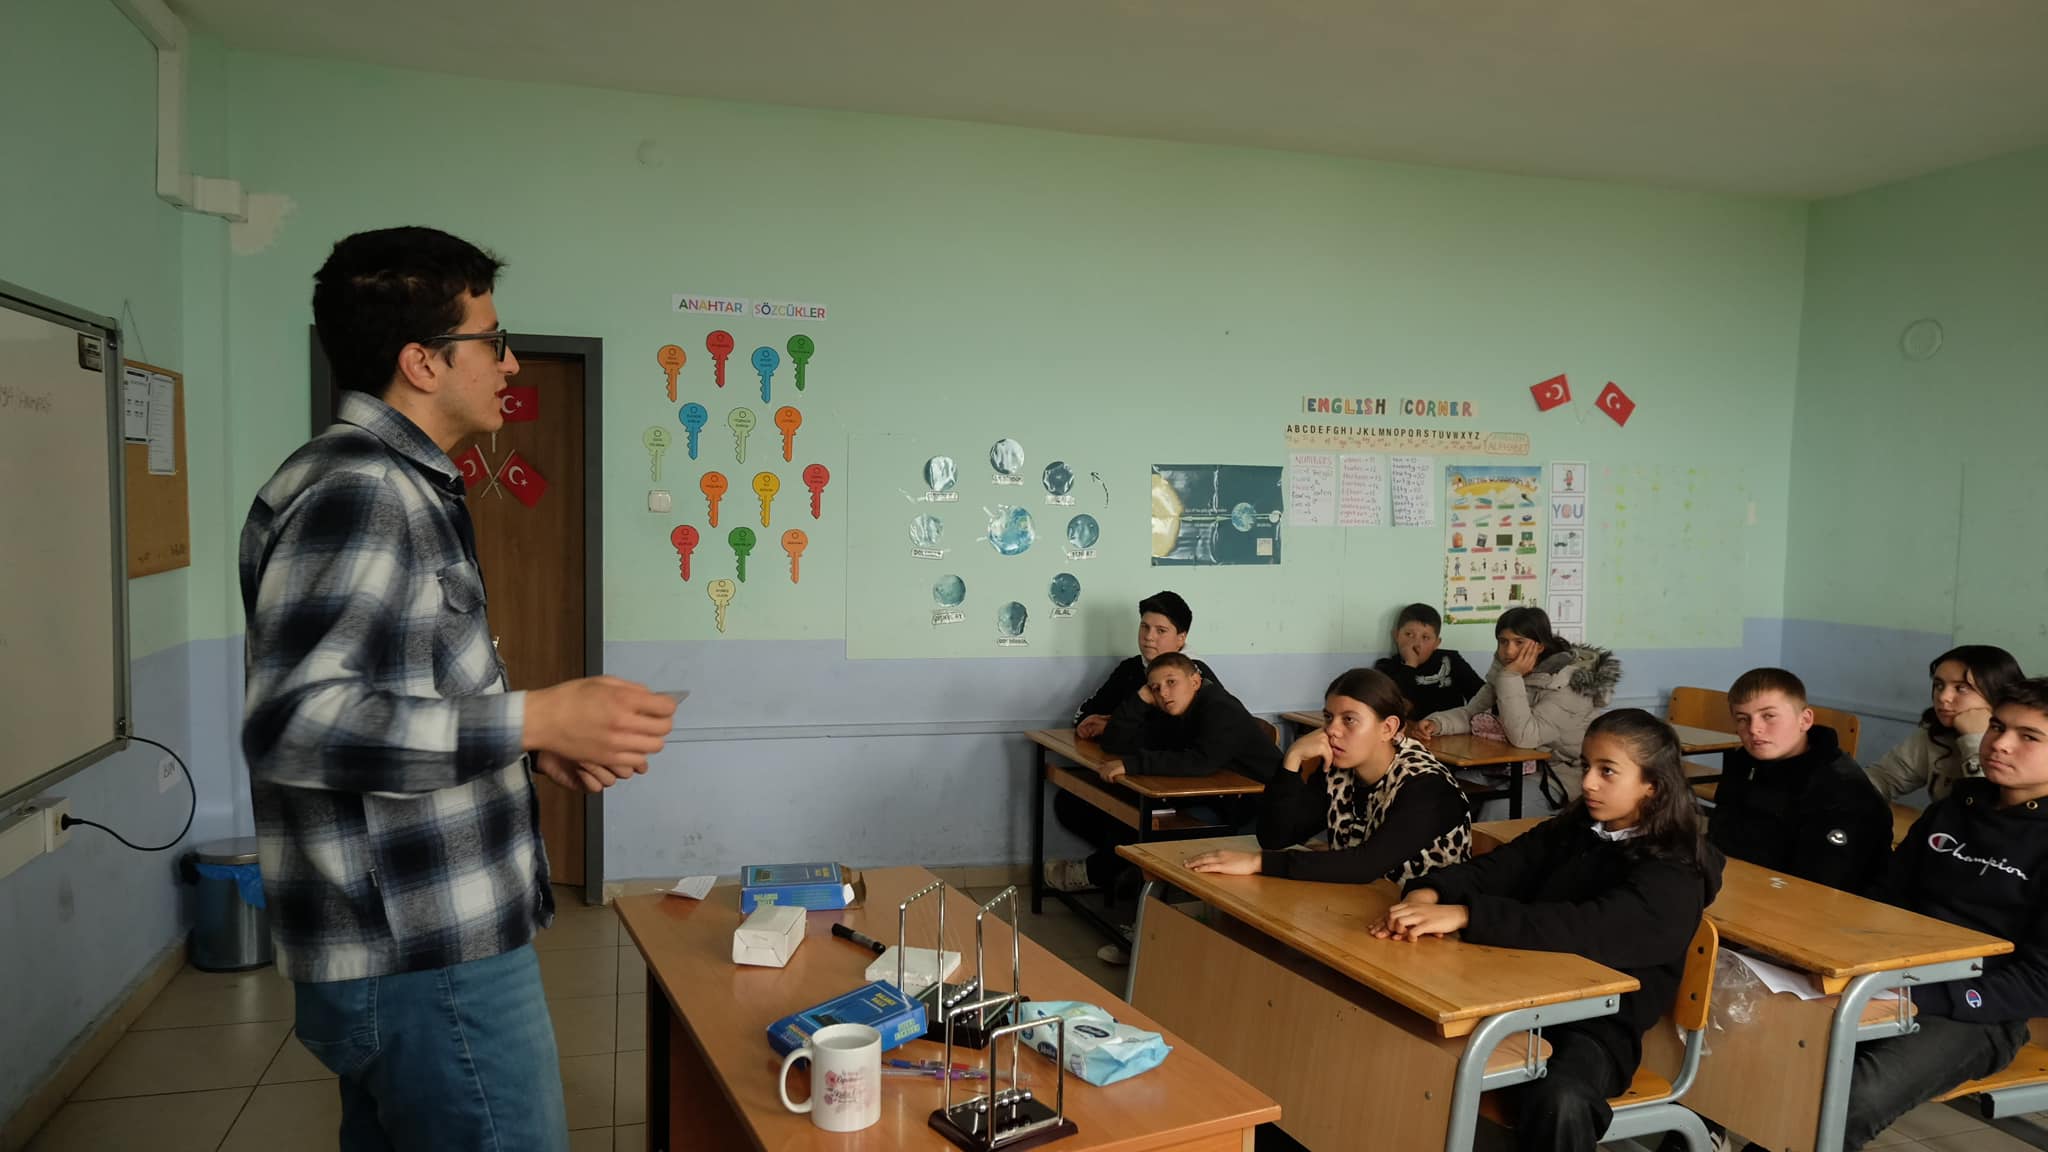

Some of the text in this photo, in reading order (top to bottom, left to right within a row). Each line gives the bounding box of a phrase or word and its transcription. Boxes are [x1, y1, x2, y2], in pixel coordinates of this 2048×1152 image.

[678, 298, 826, 319] ANAHTAR SÖZCÜKLER
[1307, 397, 1473, 417] ENGLISH CORNER
[1552, 503, 1583, 519] YOU
[1928, 832, 2029, 881] Champion
